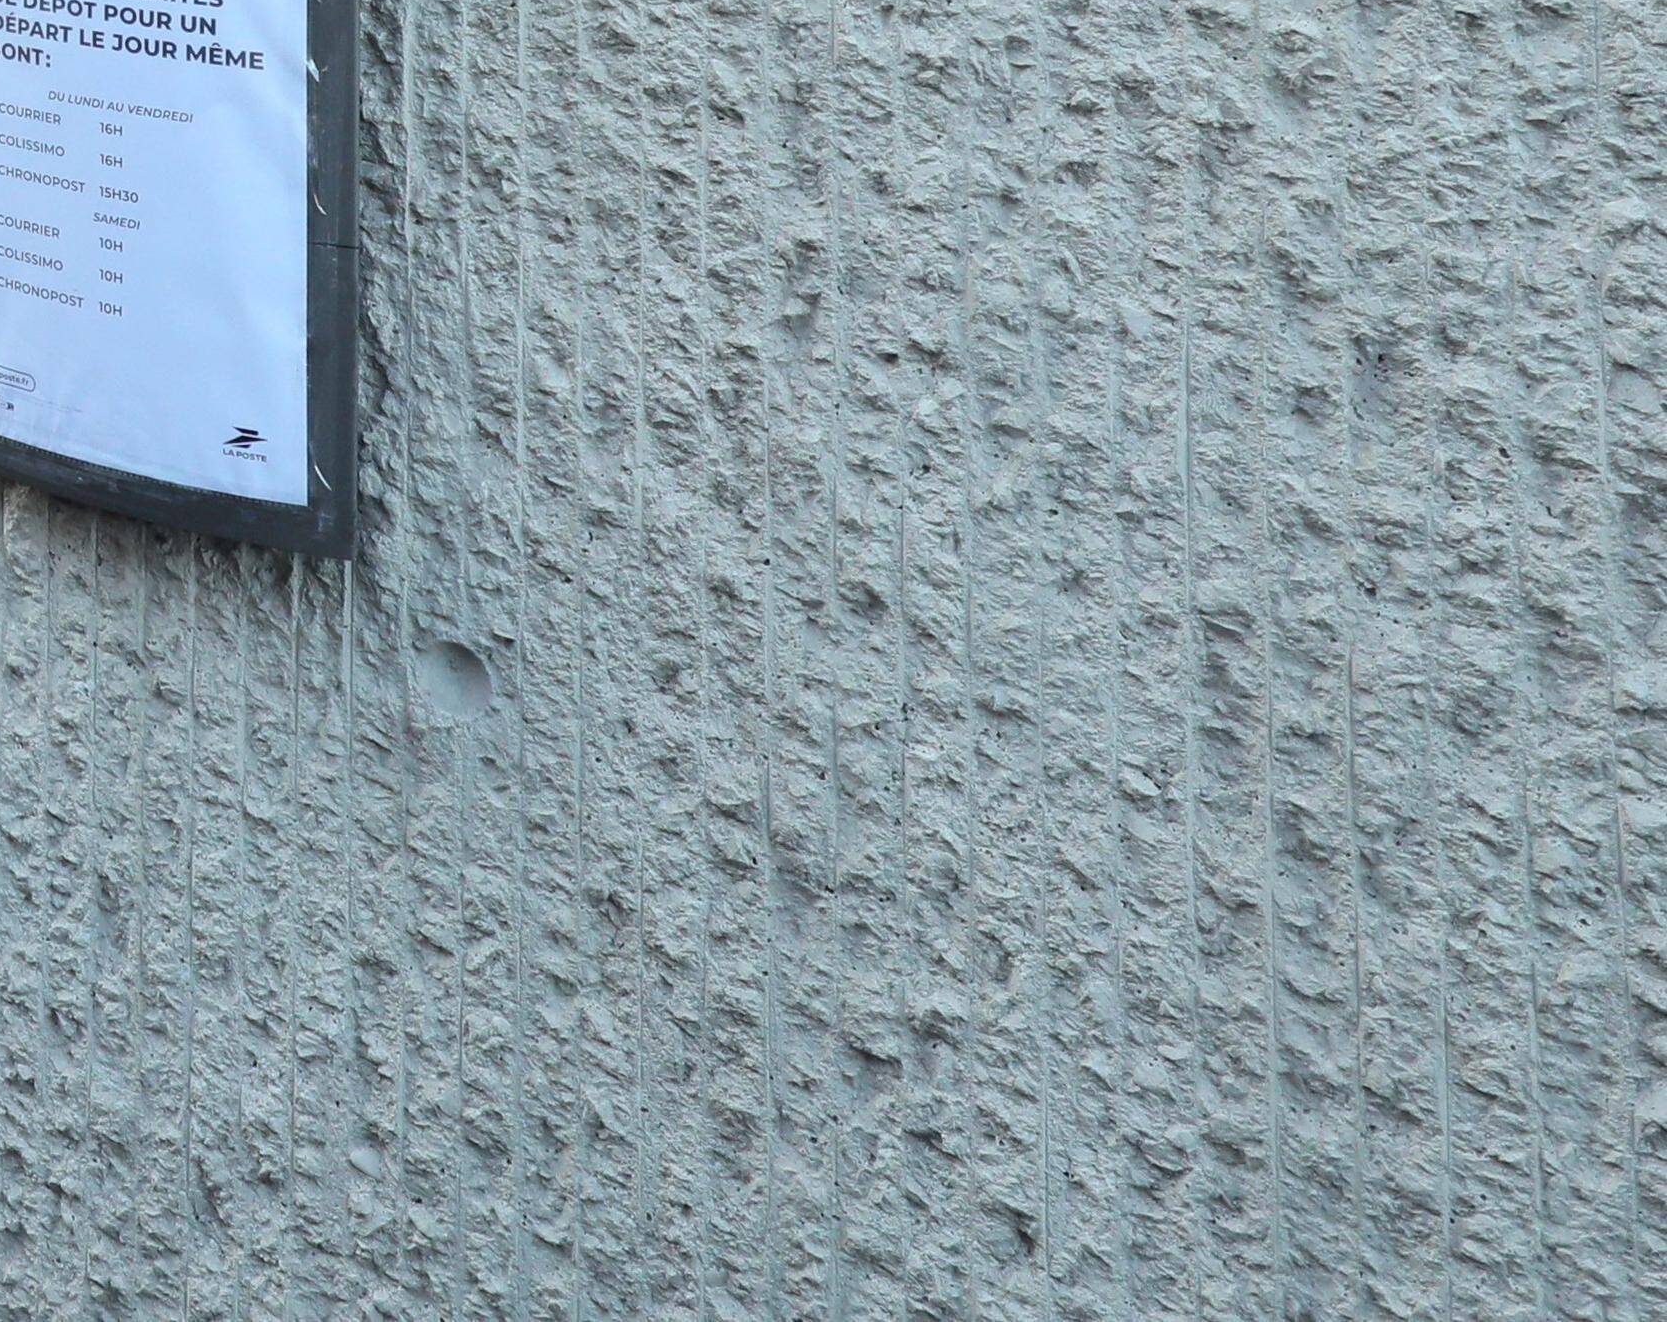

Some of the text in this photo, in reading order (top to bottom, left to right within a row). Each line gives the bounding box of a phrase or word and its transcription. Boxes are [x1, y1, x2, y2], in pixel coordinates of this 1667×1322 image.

[103, 4, 172, 30] POUR
[180, 15, 217, 36] UN
[79, 28, 105, 49] LE
[112, 34, 177, 60] JOUR
[185, 43, 264, 70] MÊME
[47, 90, 194, 123] DU LUNDI AU VENDREDI
[99, 122, 123, 136] 16H
[99, 154, 123, 168] 16H
[99, 186, 139, 204] 15H30
[92, 212, 141, 230] SAMEDI
[99, 237, 123, 252] 10H
[99, 268, 123, 284] 10H
[99, 301, 123, 316] 10H
[222, 448, 267, 463] LA POSTE
